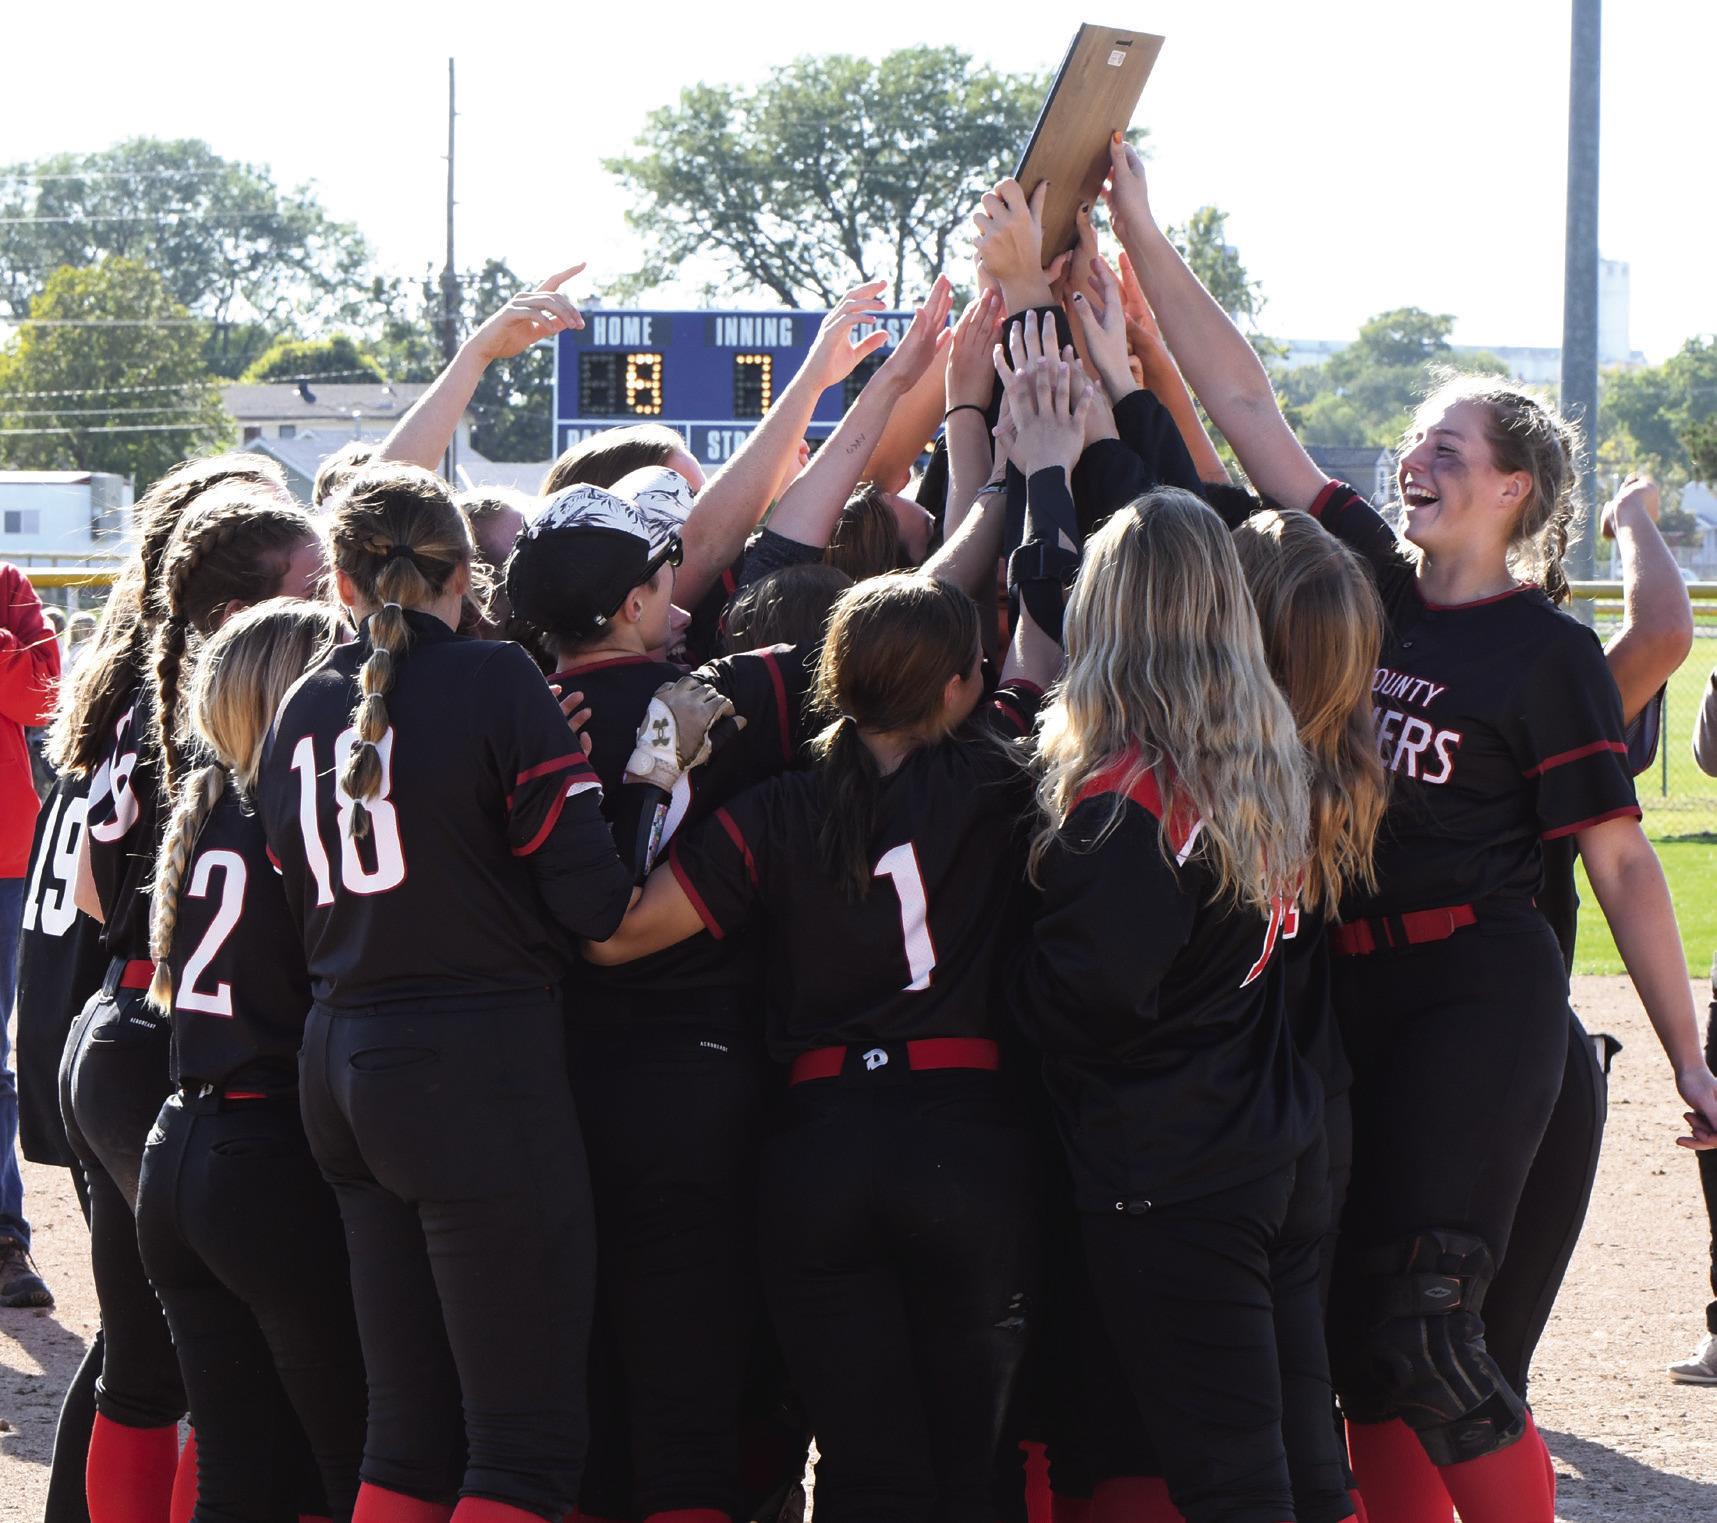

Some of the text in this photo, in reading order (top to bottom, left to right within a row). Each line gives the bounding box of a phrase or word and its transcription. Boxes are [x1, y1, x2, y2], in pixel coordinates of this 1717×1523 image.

[593, 316, 653, 346] HOME
[715, 317, 793, 347] INNING
[736, 354, 772, 415] 7
[707, 430, 753, 460] STR
[1371, 667, 1448, 709] OUNTY
[290, 723, 408, 908] 18
[22, 794, 88, 937] 19
[176, 847, 248, 1018] 2
[873, 839, 938, 993] 1
